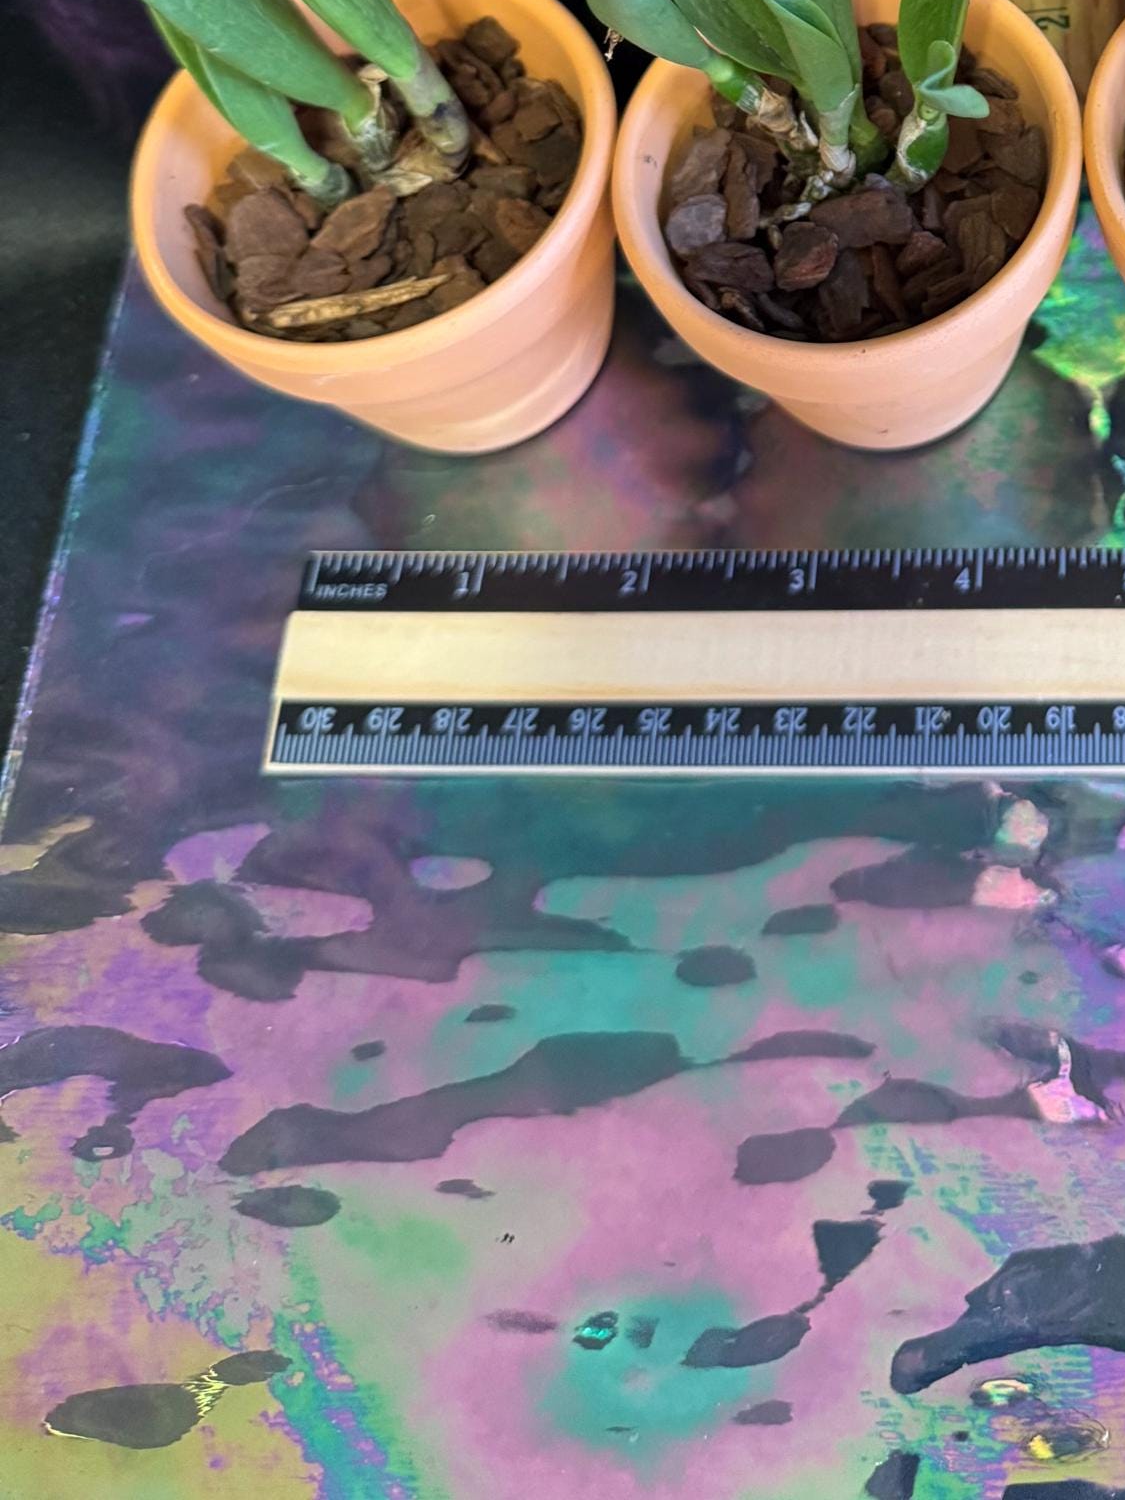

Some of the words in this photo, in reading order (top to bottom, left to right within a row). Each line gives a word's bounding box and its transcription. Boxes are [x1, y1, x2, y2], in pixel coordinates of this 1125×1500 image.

[1035, 15, 1070, 30] 2
[316, 583, 388, 599] INCHES
[453, 571, 469, 597] 1
[619, 571, 638, 596] 2
[787, 569, 804, 594] 3
[953, 567, 970, 592] 4
[301, 707, 337, 729] 30
[366, 707, 405, 729] 29
[432, 707, 473, 730] 28
[502, 707, 539, 730] 27
[569, 708, 607, 731] 26
[638, 708, 672, 731] 25
[705, 707, 741, 731] 24
[773, 707, 808, 731] 23
[843, 707, 877, 731] 22
[915, 706, 944, 730] 21
[977, 706, 1012, 730] 20
[1045, 706, 1076, 729] 19
